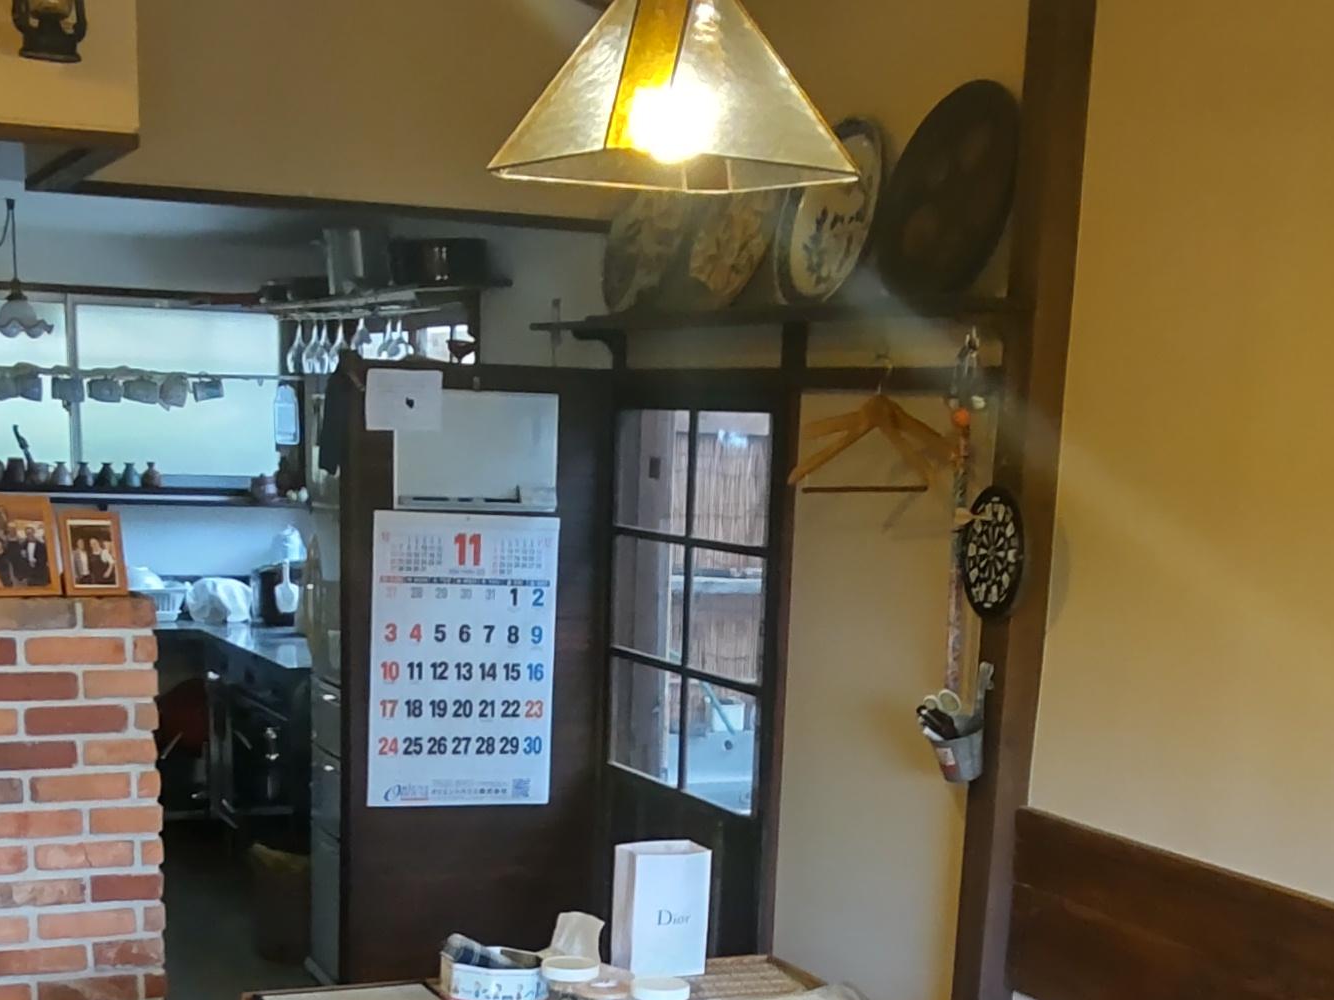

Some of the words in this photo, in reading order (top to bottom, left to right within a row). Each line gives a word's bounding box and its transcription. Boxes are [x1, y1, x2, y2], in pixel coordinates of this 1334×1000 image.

[454, 533, 481, 566] 11
[485, 588, 496, 600] 31
[510, 587, 518, 606] 1
[532, 588, 544, 607] 2
[385, 623, 397, 642] 3
[410, 624, 422, 642] 4
[434, 624, 446, 643] 5
[459, 624, 471, 643] 6
[483, 625, 495, 643] 7
[507, 625, 519, 644] 8
[531, 626, 543, 644] 9
[381, 661, 399, 680] 10
[407, 661, 423, 680] 11
[430, 661, 448, 680] 12
[455, 662, 472, 681] 13
[479, 662, 497, 681] 14
[503, 662, 521, 681] 15
[527, 663, 544, 681] 16
[380, 699, 398, 718] 17
[405, 699, 423, 718] 18
[429, 699, 448, 718] 19
[452, 699, 473, 718] 20
[478, 699, 495, 718] 21
[501, 699, 520, 718] 22
[525, 699, 543, 718] 23
[378, 737, 398, 755] 24
[403, 737, 423, 755] 25
[427, 737, 447, 755] 26
[452, 737, 471, 755] 27
[475, 737, 495, 755] 28
[499, 736, 519, 754] 29
[523, 736, 542, 754] 30
[657, 910, 692, 926] Dior
